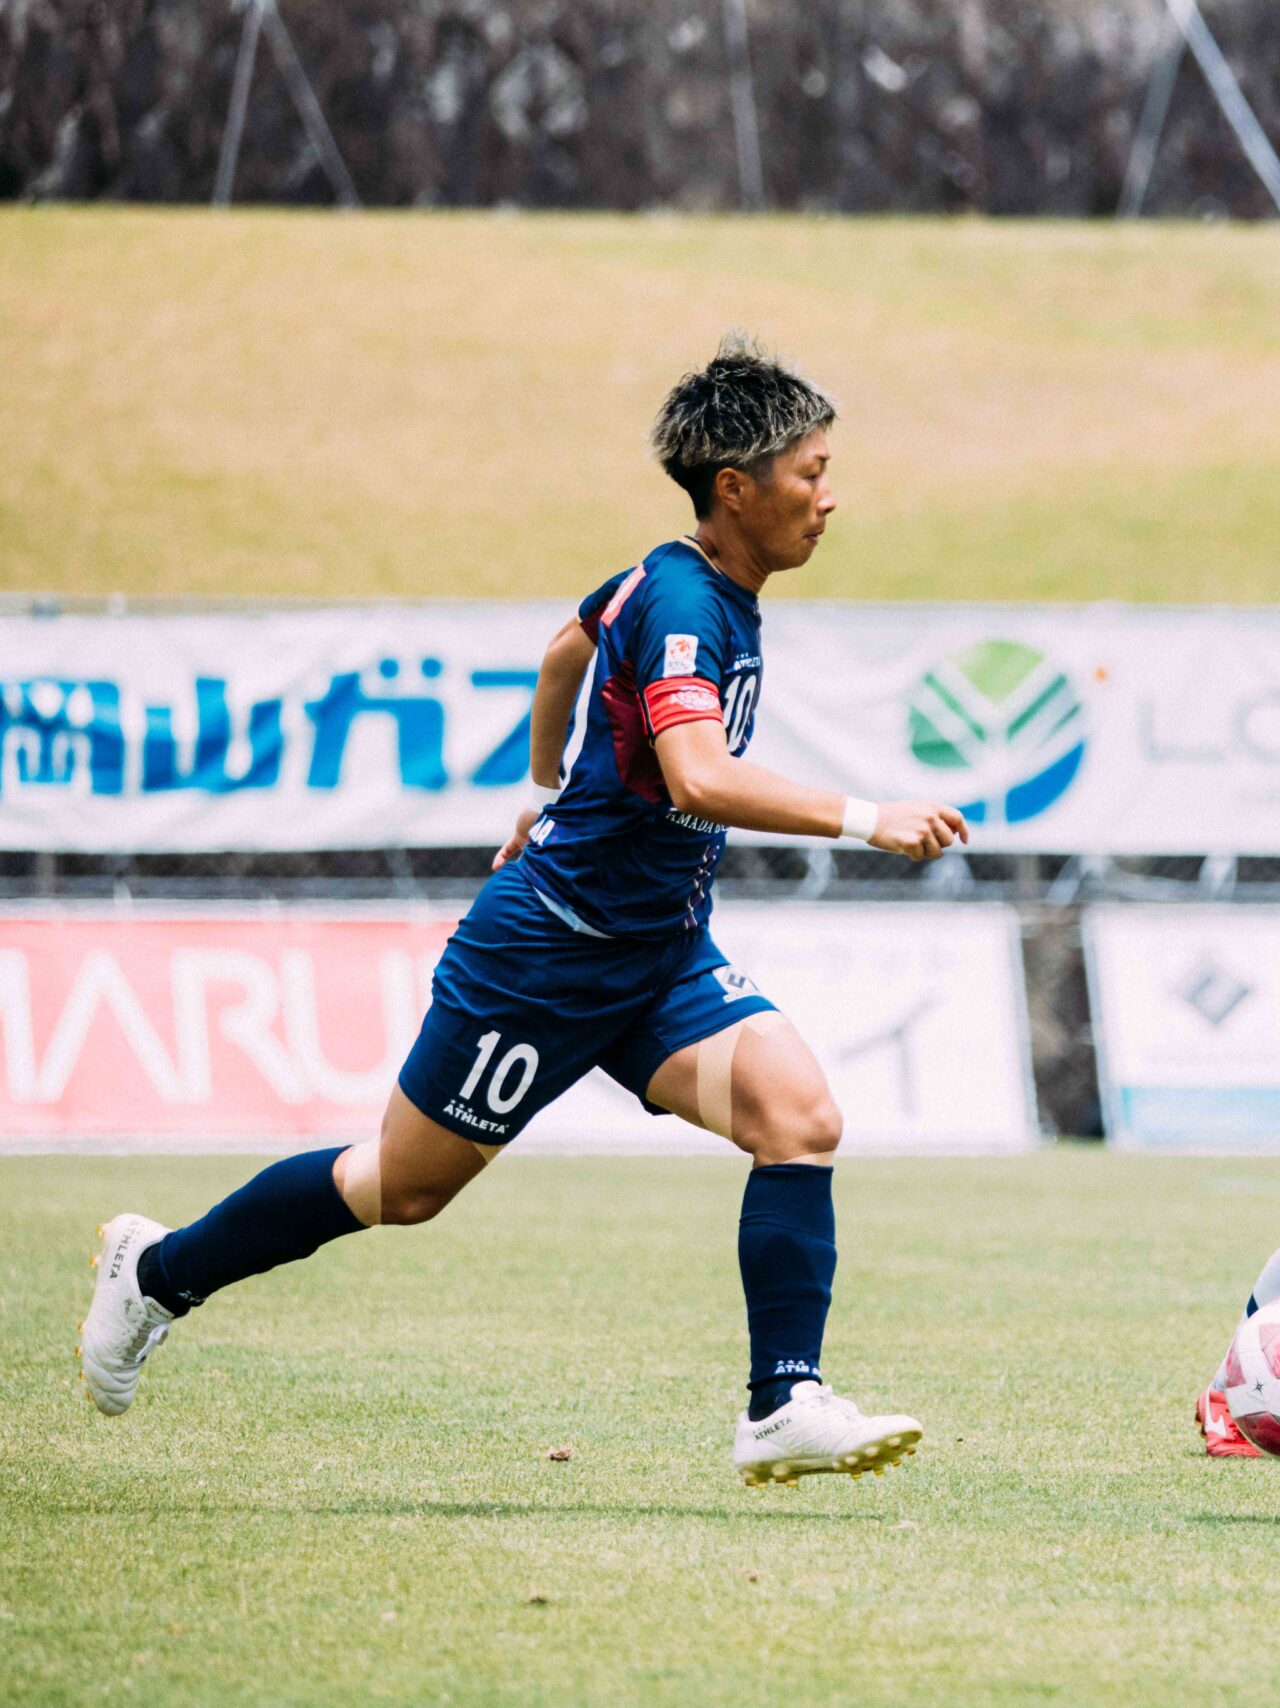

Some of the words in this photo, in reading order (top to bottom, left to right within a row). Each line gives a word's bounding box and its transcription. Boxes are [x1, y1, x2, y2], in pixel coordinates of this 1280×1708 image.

[724, 675, 757, 752] 10
[459, 1030, 539, 1114] 10
[443, 1103, 507, 1134] ATHLETA
